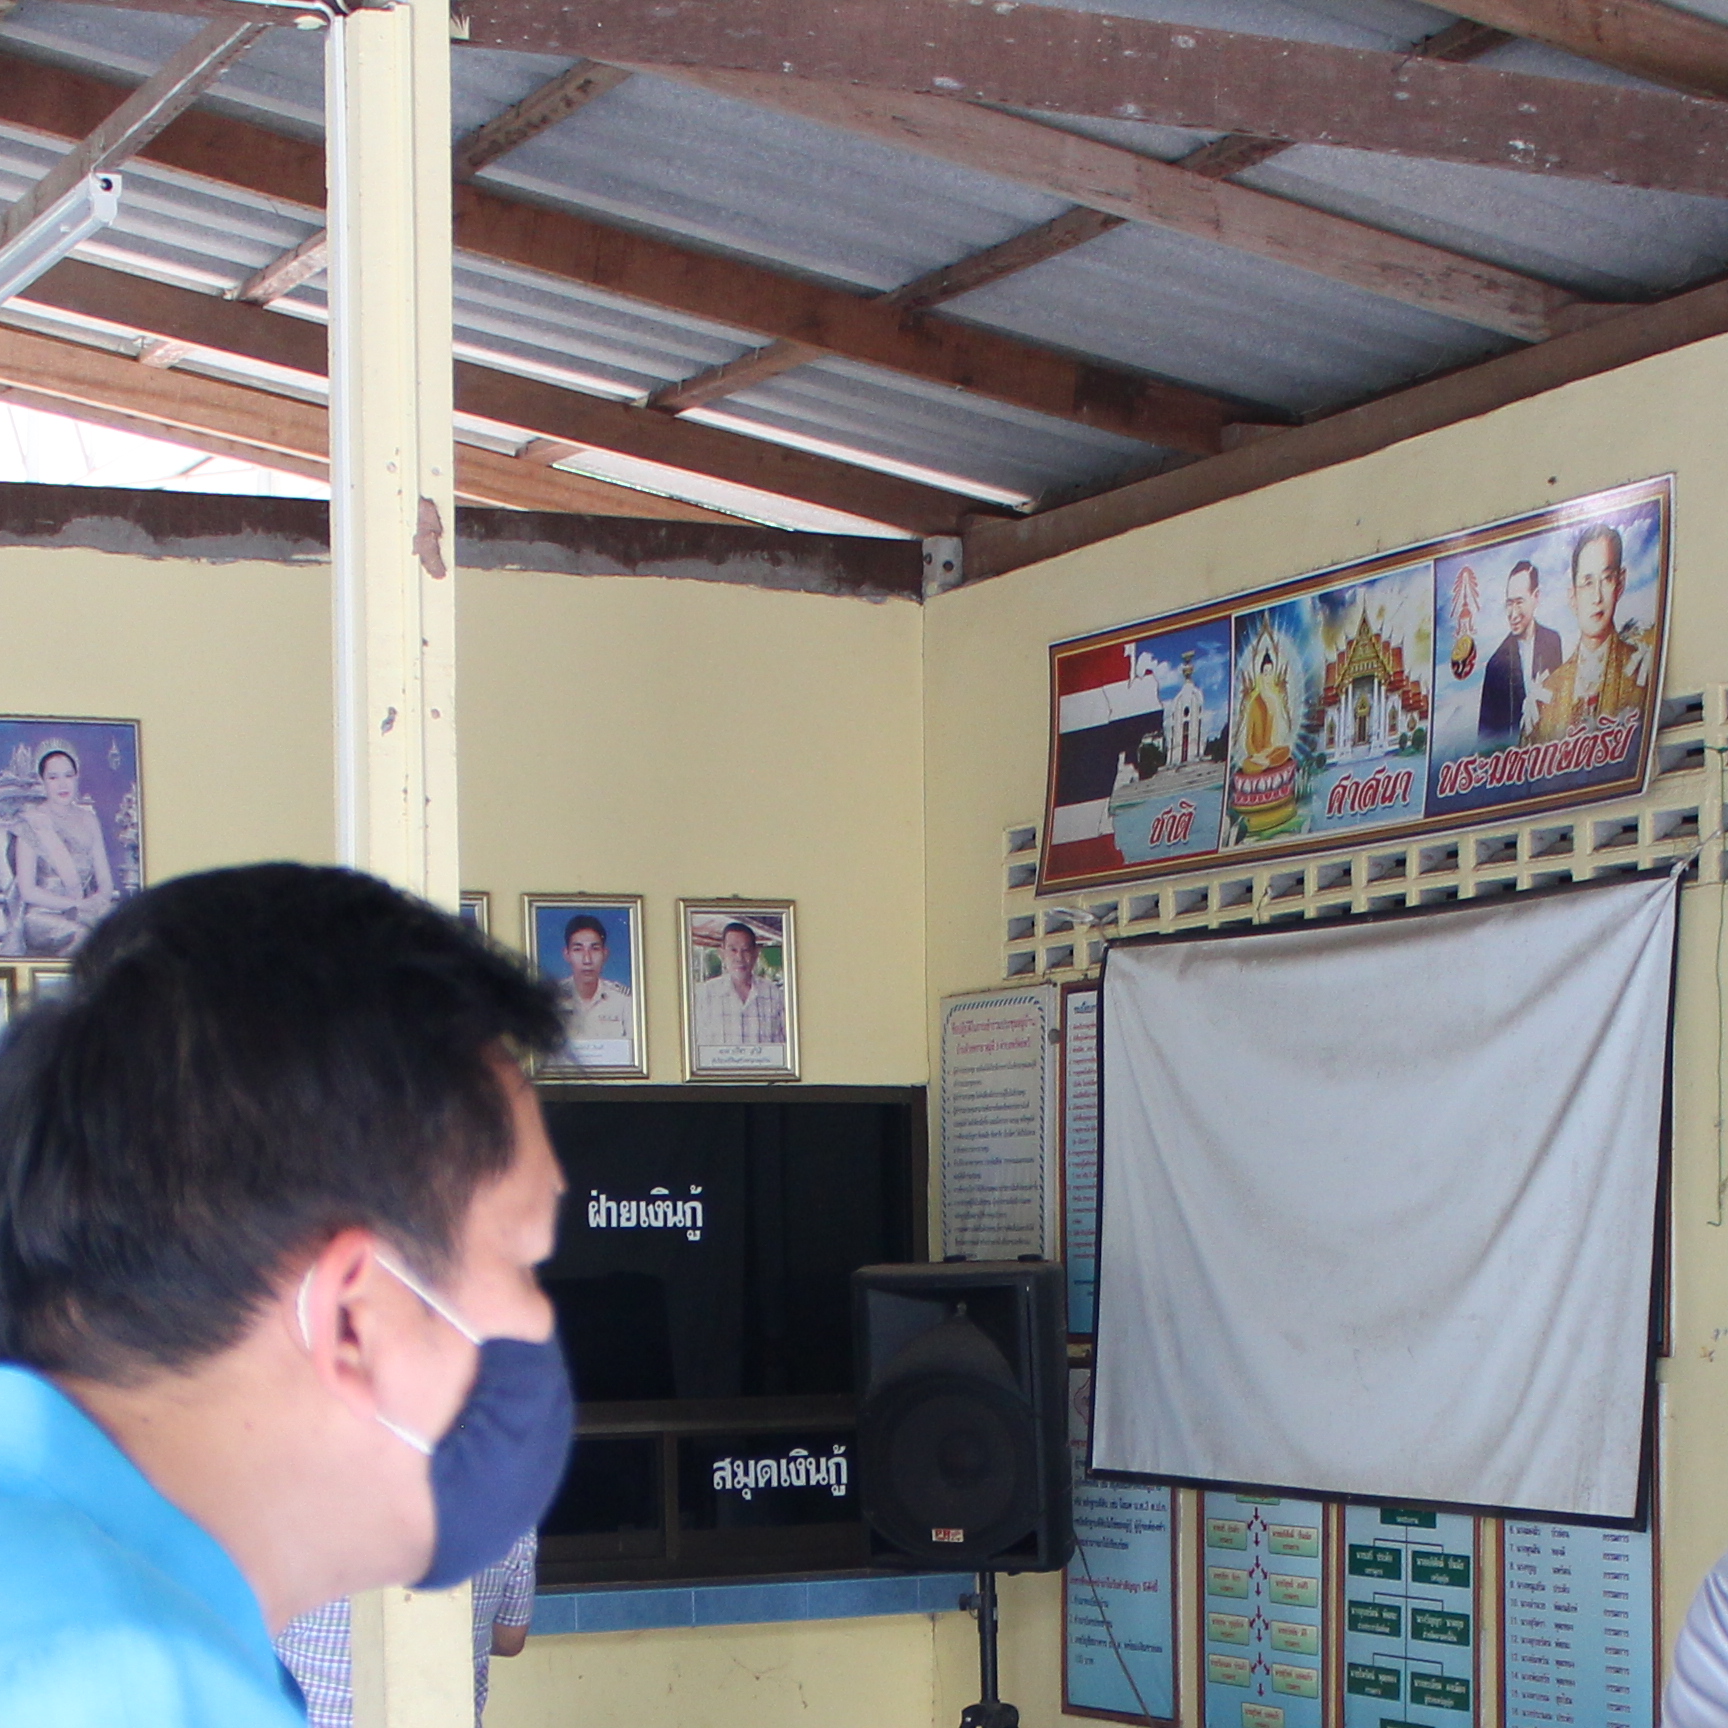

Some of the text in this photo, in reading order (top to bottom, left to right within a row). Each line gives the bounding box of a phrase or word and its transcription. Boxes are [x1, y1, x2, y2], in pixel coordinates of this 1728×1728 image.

[1149, 711, 1636, 846] ชาติ ศาสนา พระมหากษัตริย์
[588, 1185, 703, 1241] ฝ่ายเงินกู้
[713, 1444, 848, 1500] สมุดเงินกู้
